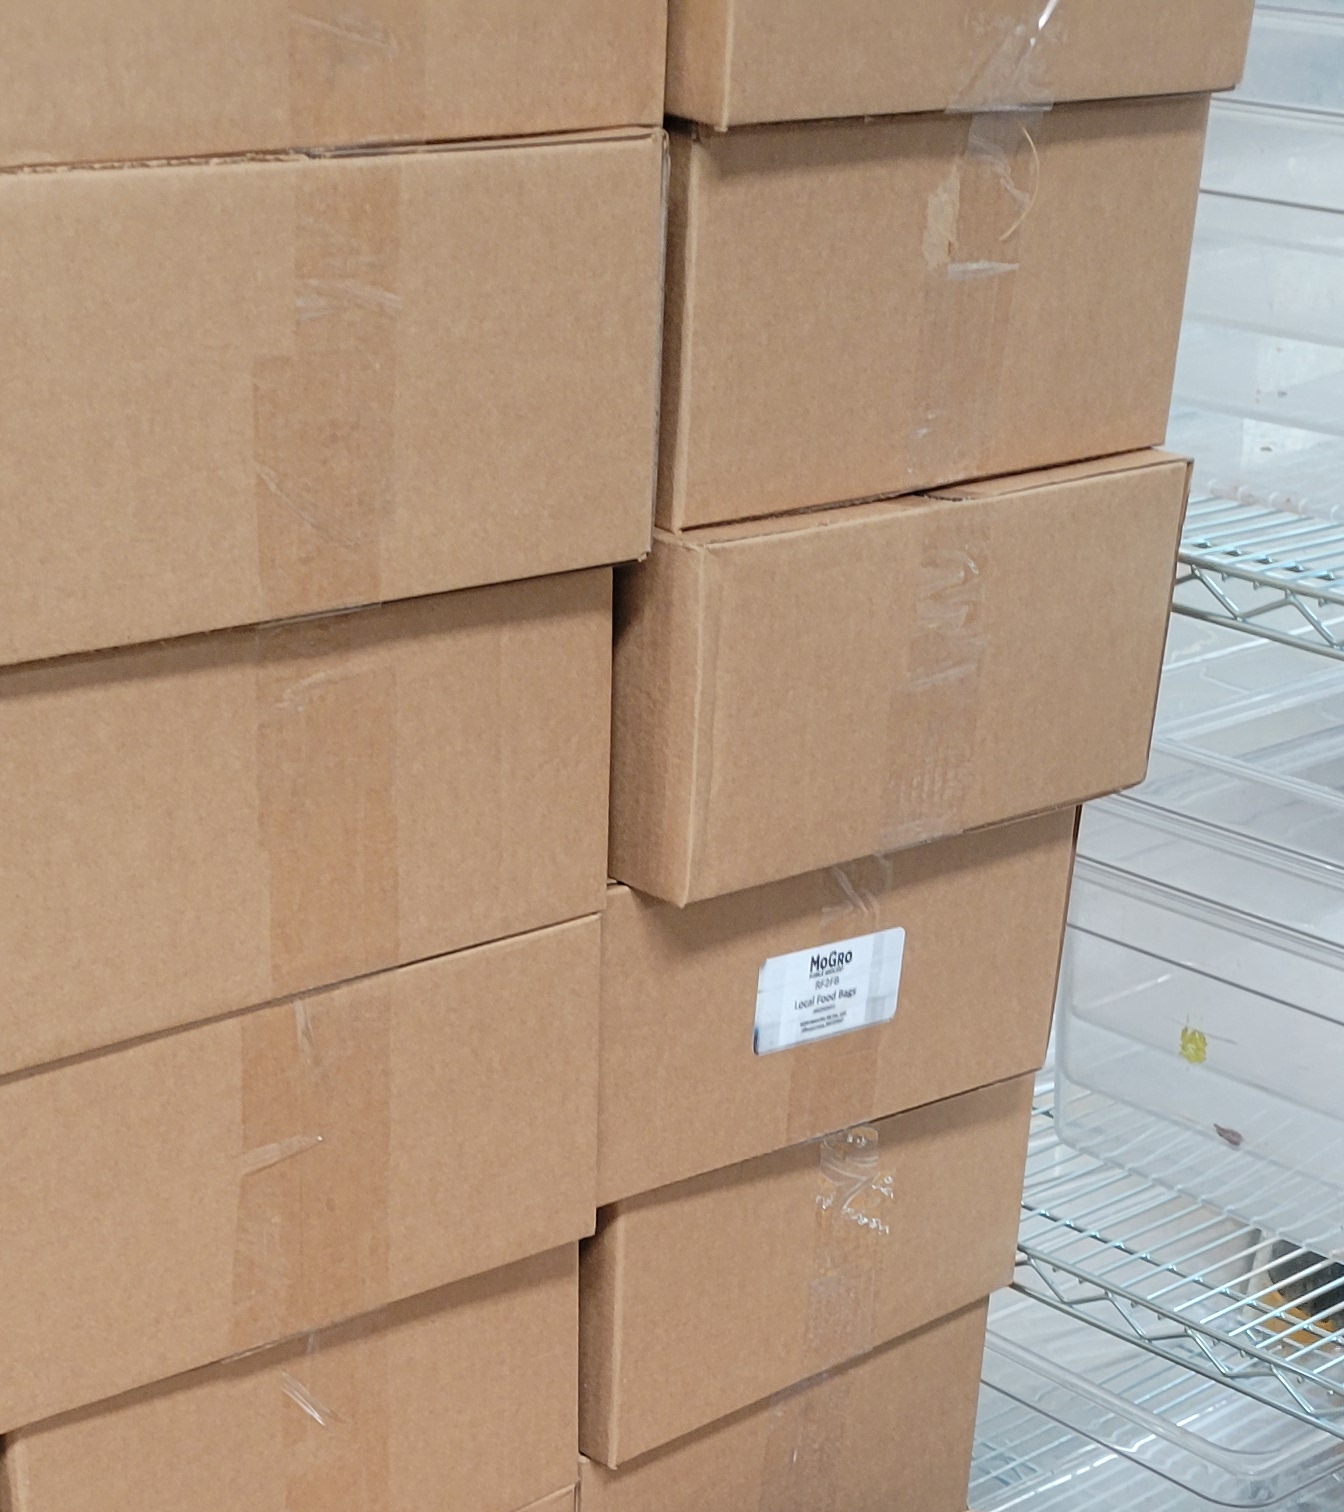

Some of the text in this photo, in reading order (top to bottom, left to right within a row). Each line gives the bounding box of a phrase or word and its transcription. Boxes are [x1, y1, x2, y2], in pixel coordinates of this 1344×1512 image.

[794, 995, 814, 1010] Local
[817, 989, 836, 1005] Food
[839, 987, 856, 1001] Bags
